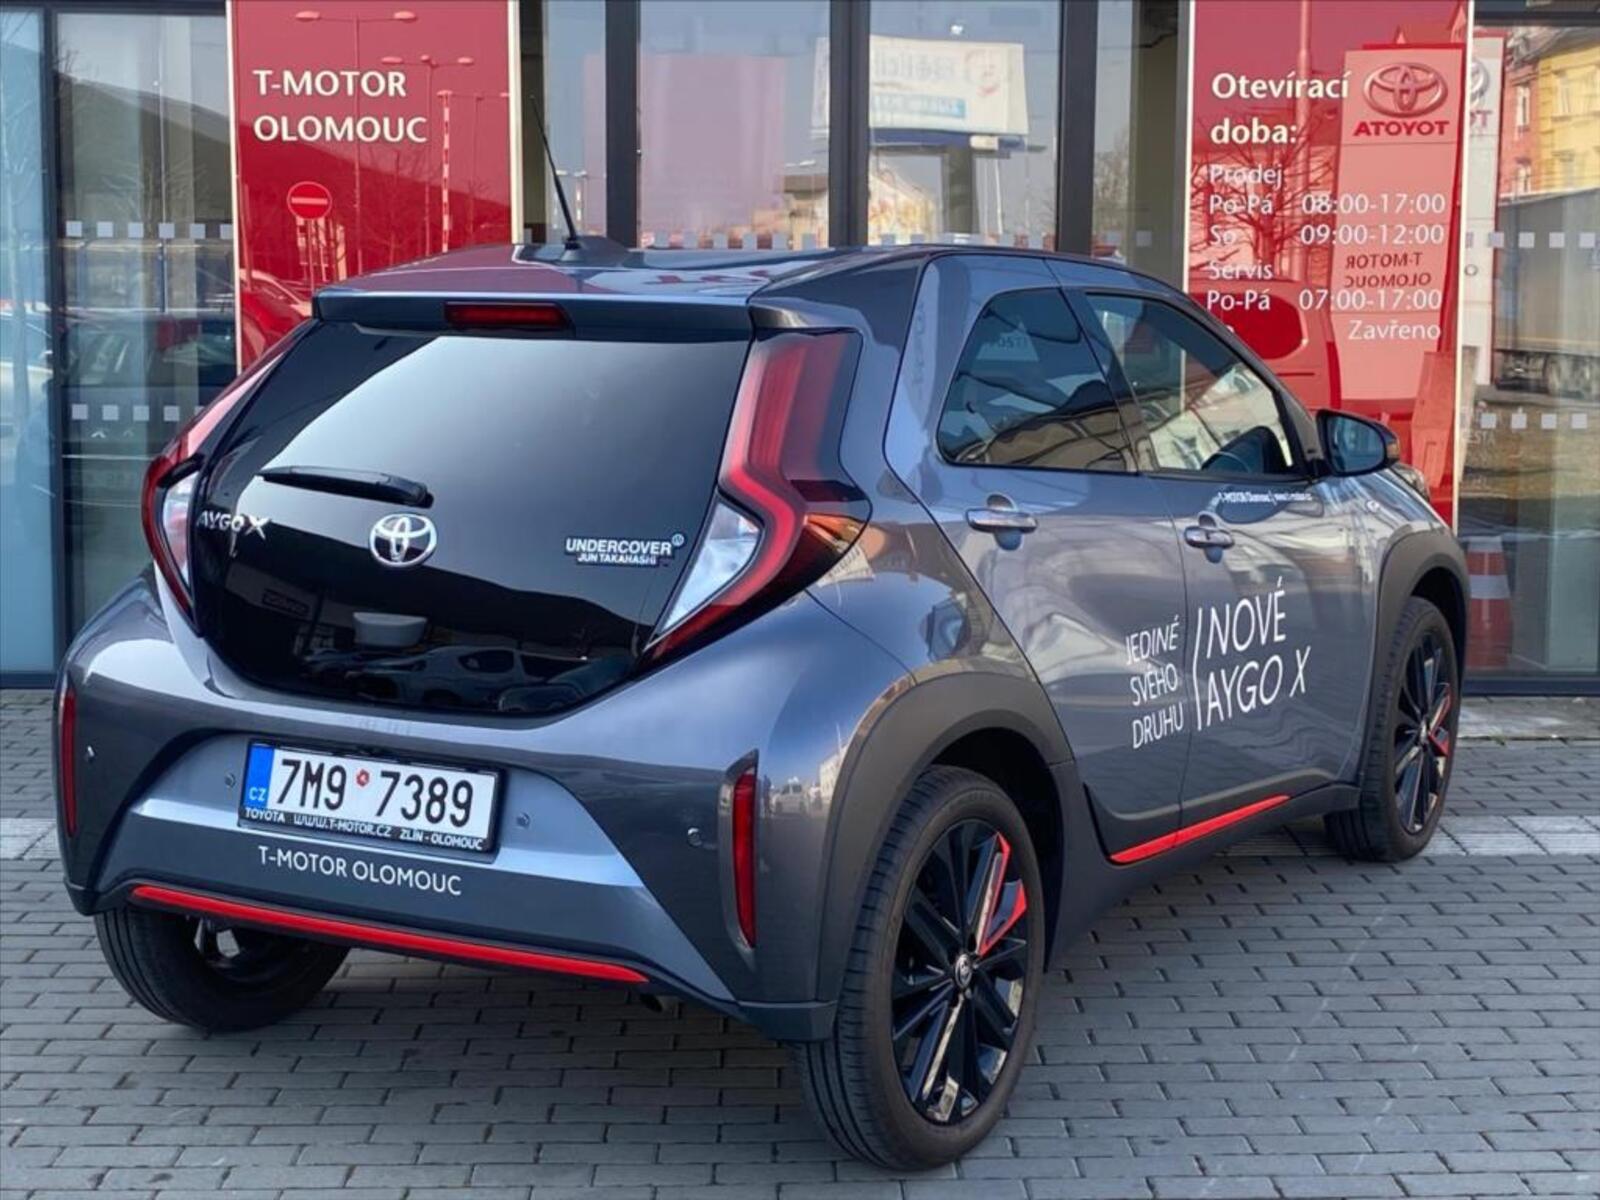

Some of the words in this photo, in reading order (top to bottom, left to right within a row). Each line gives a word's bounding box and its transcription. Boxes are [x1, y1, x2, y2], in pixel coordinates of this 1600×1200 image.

[252, 69, 406, 97] T-MOTOR
[1212, 71, 1349, 98] Otevírací
[253, 115, 427, 142] OLOMOUC
[1210, 117, 1297, 144] doba:
[1209, 164, 1283, 190] Prodej
[1209, 194, 1273, 214] Po-Pá
[1301, 193, 1446, 214] 08:00-17:00
[1210, 224, 1237, 245] So
[1300, 224, 1444, 245] 09:00-12:00
[1208, 260, 1273, 280] Servis
[1207, 289, 1271, 311] Po-Pá
[1299, 289, 1442, 311] 07:00-17:00
[1348, 320, 1441, 340] Zavřeno
[197, 510, 244, 532] AYGO
[245, 514, 271, 540] X
[565, 537, 672, 556] UNDERCOVER
[577, 552, 598, 563] JUN
[1206, 576, 1286, 659] NOVÉ
[1125, 615, 1180, 665] JEDINÉ
[1130, 663, 1178, 706] SVÉHO
[1206, 654, 1283, 726] AYGO
[1289, 645, 1311, 698] X
[1132, 702, 1184, 749] DRUHU
[249, 787, 267, 802] CZ
[276, 759, 347, 811] 7M9
[376, 770, 474, 828] 7389
[245, 807, 286, 823] TOYOTA
[293, 815, 393, 838] WWW.T-MOTOR.CZ
[431, 834, 483, 851] OLOMOUC
[257, 845, 348, 878] T-MOTOR
[352, 860, 462, 896] OLOMOUC
